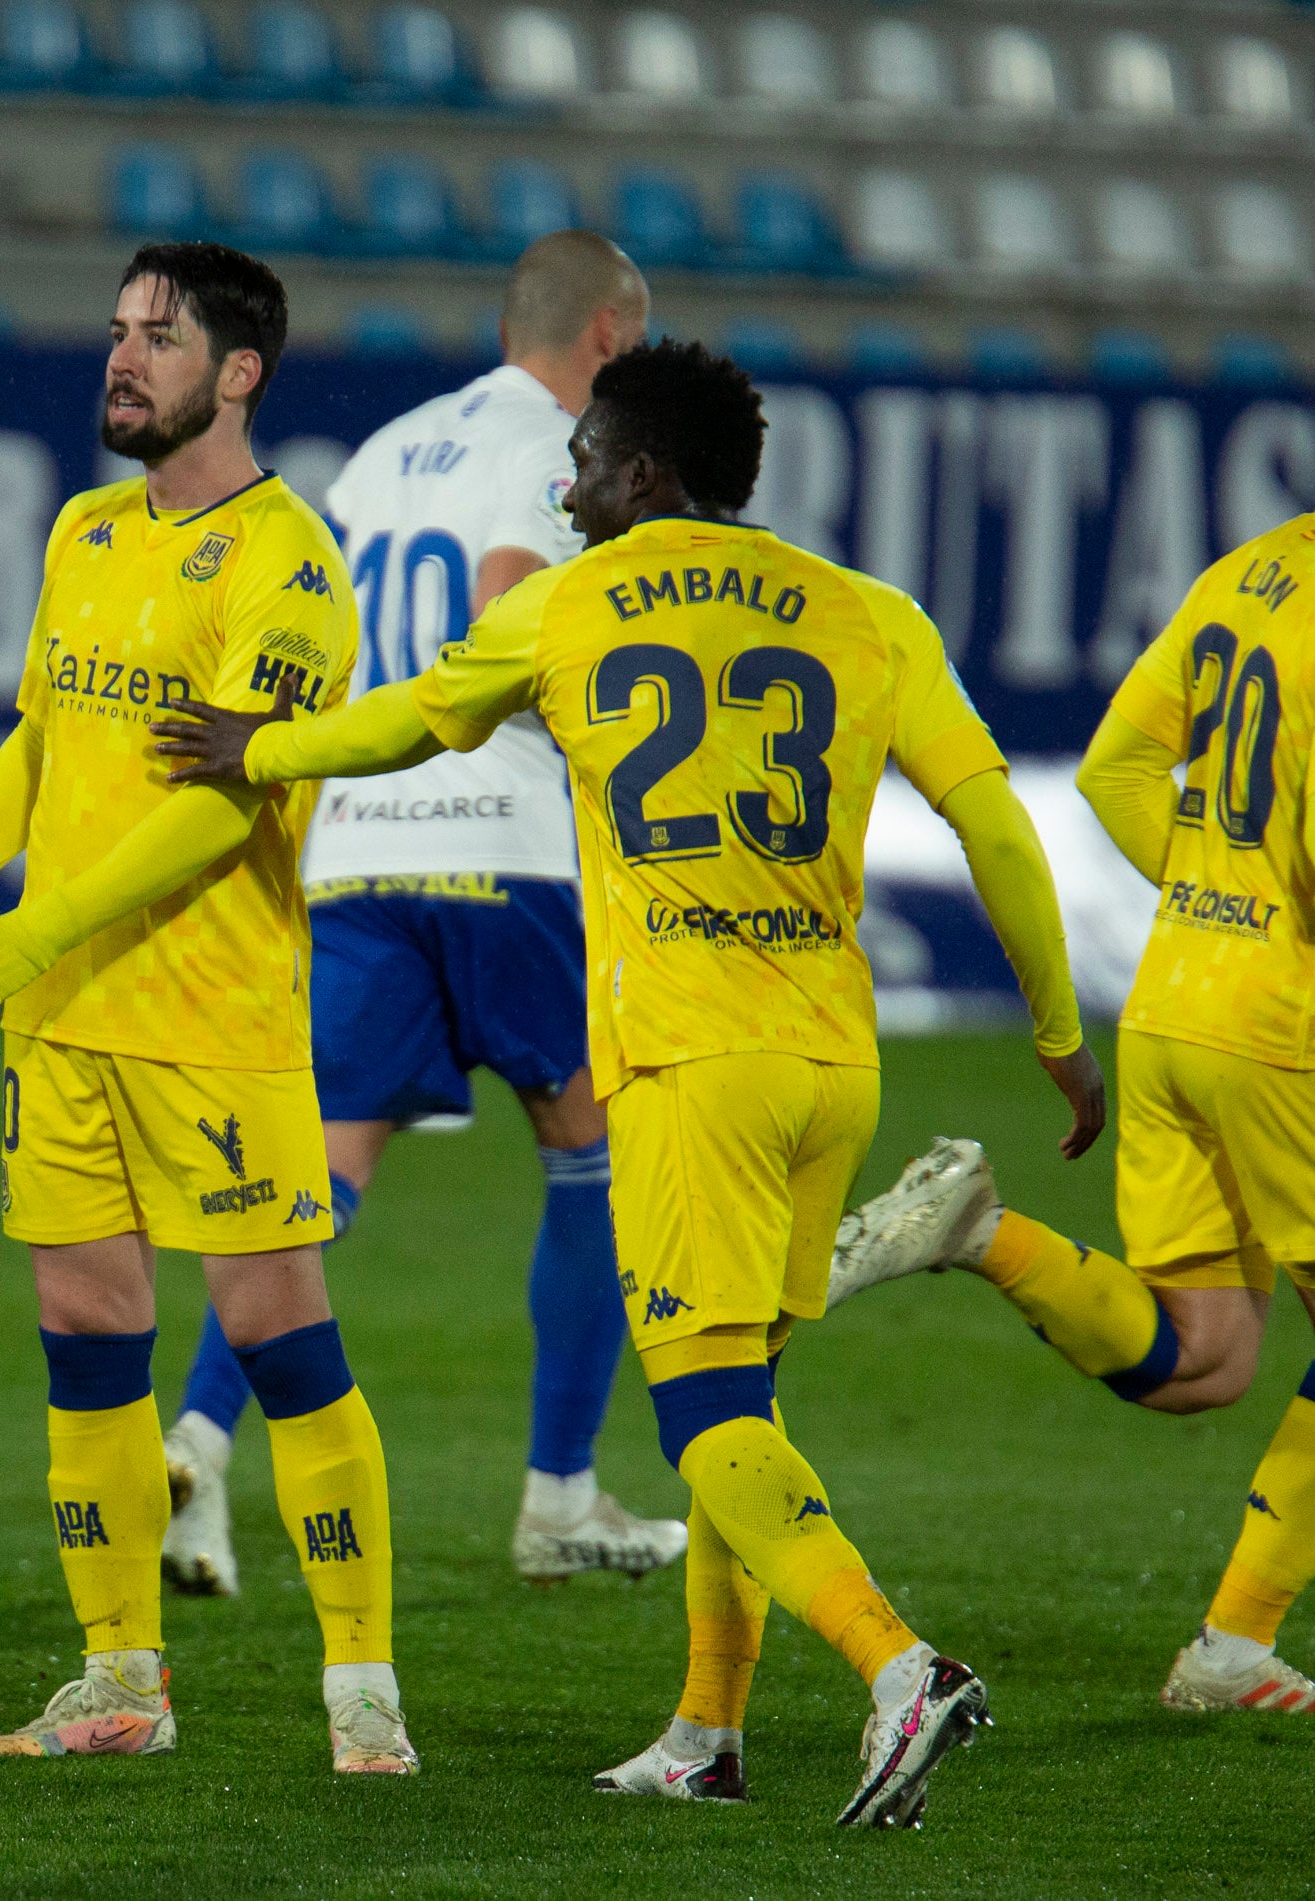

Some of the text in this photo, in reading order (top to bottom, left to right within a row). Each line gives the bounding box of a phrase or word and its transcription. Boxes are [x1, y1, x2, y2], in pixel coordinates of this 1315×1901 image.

[352, 527, 472, 690] 10
[605, 566, 806, 624] EMBALÓ
[586, 643, 837, 867] 23
[1177, 621, 1280, 850] 20
[353, 794, 515, 821] VALCARCE
[303, 1508, 363, 1562] ADA
